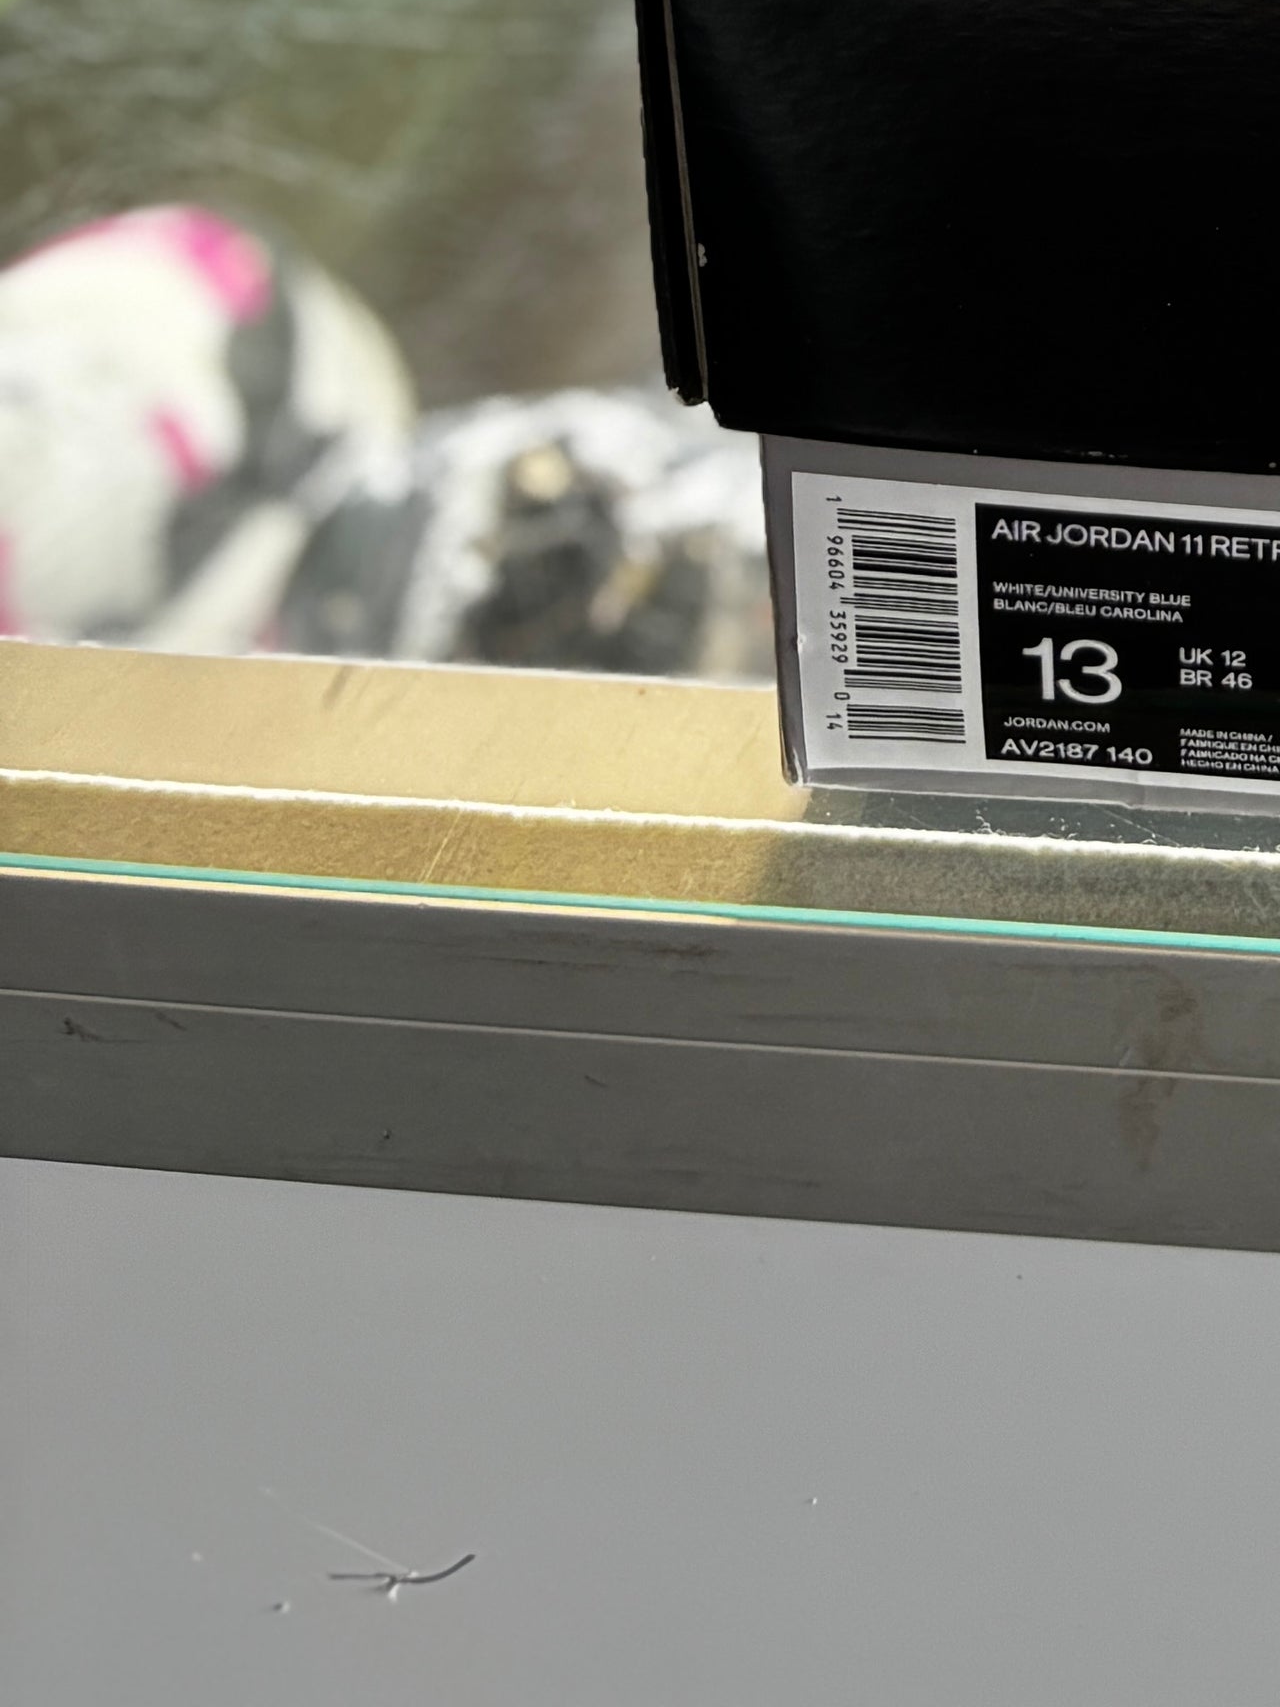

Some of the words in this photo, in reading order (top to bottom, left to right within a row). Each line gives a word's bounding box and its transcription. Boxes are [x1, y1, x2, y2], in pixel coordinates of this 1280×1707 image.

[991, 518, 1042, 543] AIR
[1046, 522, 1175, 554] JORDAN
[1181, 533, 1203, 555] 11
[827, 535, 845, 590] 96604
[992, 581, 1146, 604] WHITE/UNIVERSITY
[1149, 593, 1192, 607] BLUE
[993, 598, 1097, 617] BLANC/BLEU
[1100, 605, 1184, 623] CAROLINA
[829, 610, 848, 664] 35929
[1179, 647, 1214, 666] UK
[1221, 650, 1247, 667] 12
[1022, 637, 1122, 704] 13
[1179, 668, 1213, 687] BR
[1220, 672, 1253, 689] 46
[1003, 716, 1111, 733] JORDAN.COM
[1180, 728, 1214, 739] MADE
[1001, 738, 1100, 761] AV2187
[1106, 746, 1153, 765] 140
